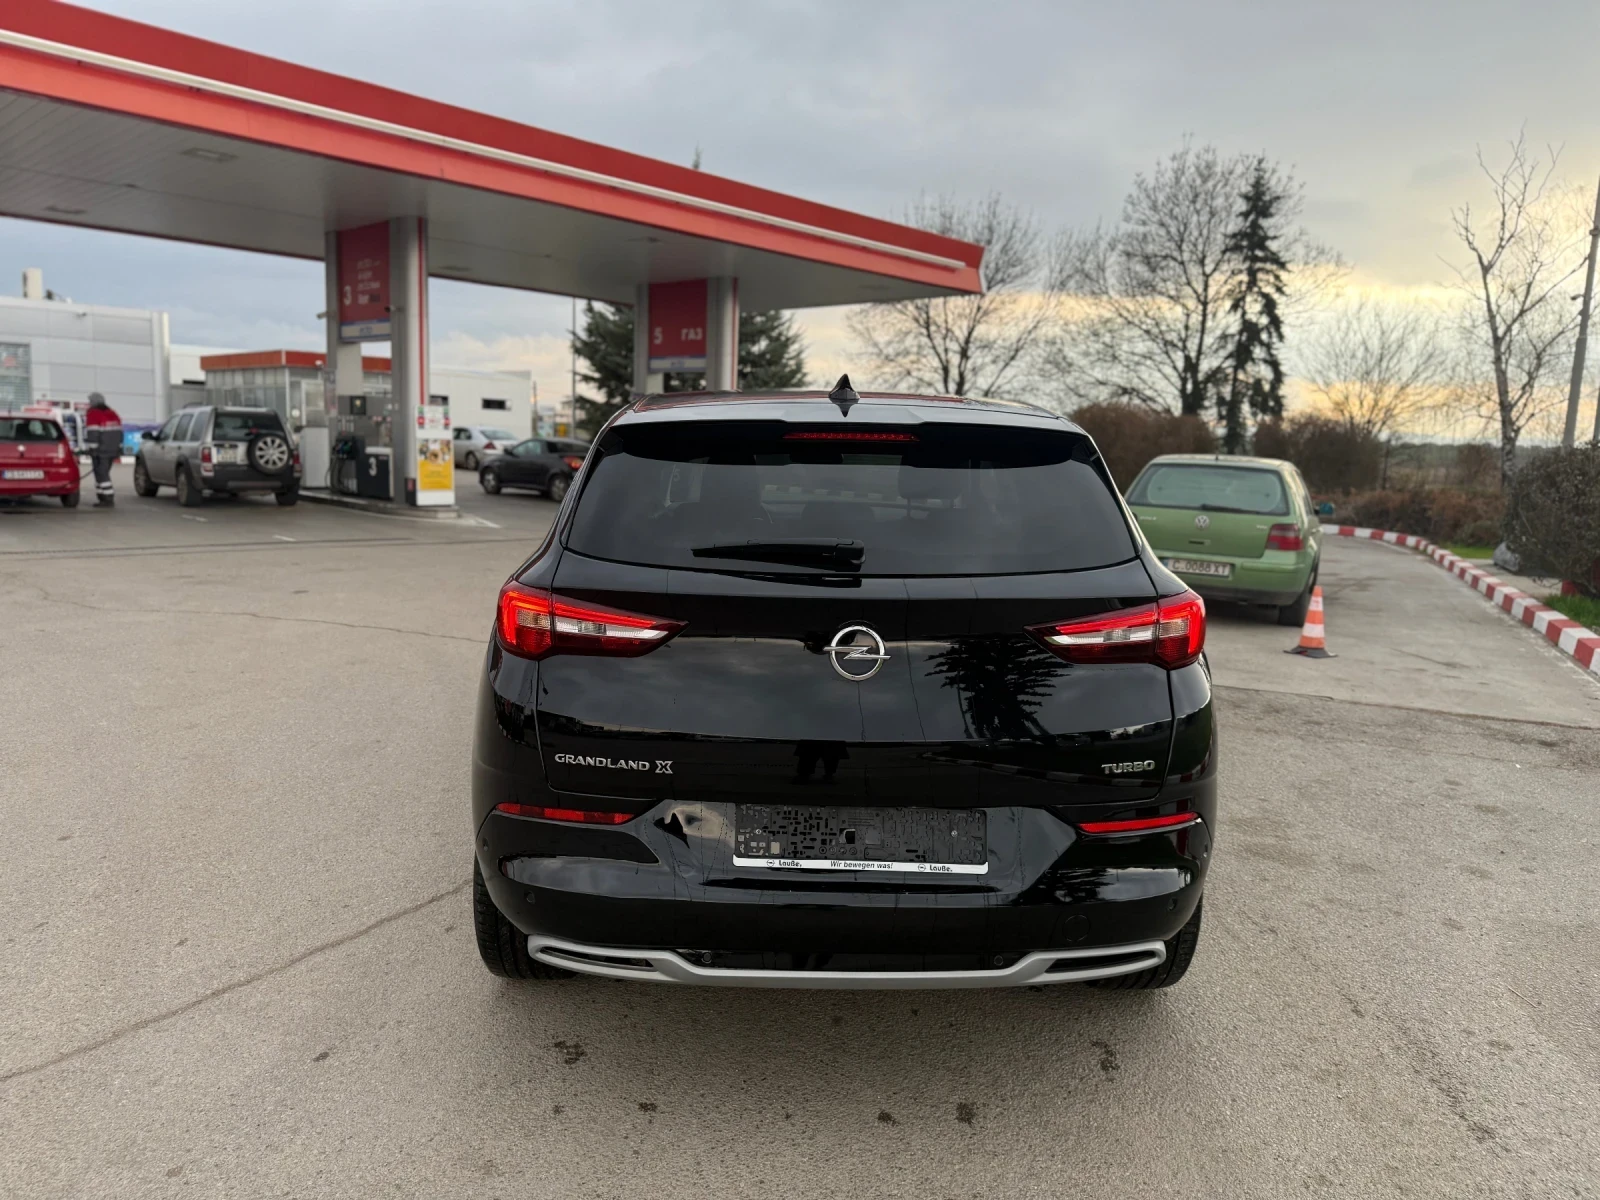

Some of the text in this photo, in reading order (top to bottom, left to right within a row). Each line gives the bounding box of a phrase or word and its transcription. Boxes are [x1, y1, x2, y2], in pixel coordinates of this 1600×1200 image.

[343, 285, 352, 306] 3
[653, 327, 663, 345] 5
[681, 328, 703, 341] ГАЗ
[368, 457, 377, 476] 3
[554, 753, 674, 774] GRANDLAND X
[1101, 760, 1156, 774] TURBO
[830, 860, 843, 868] Wir
[843, 861, 875, 870] bewegen
